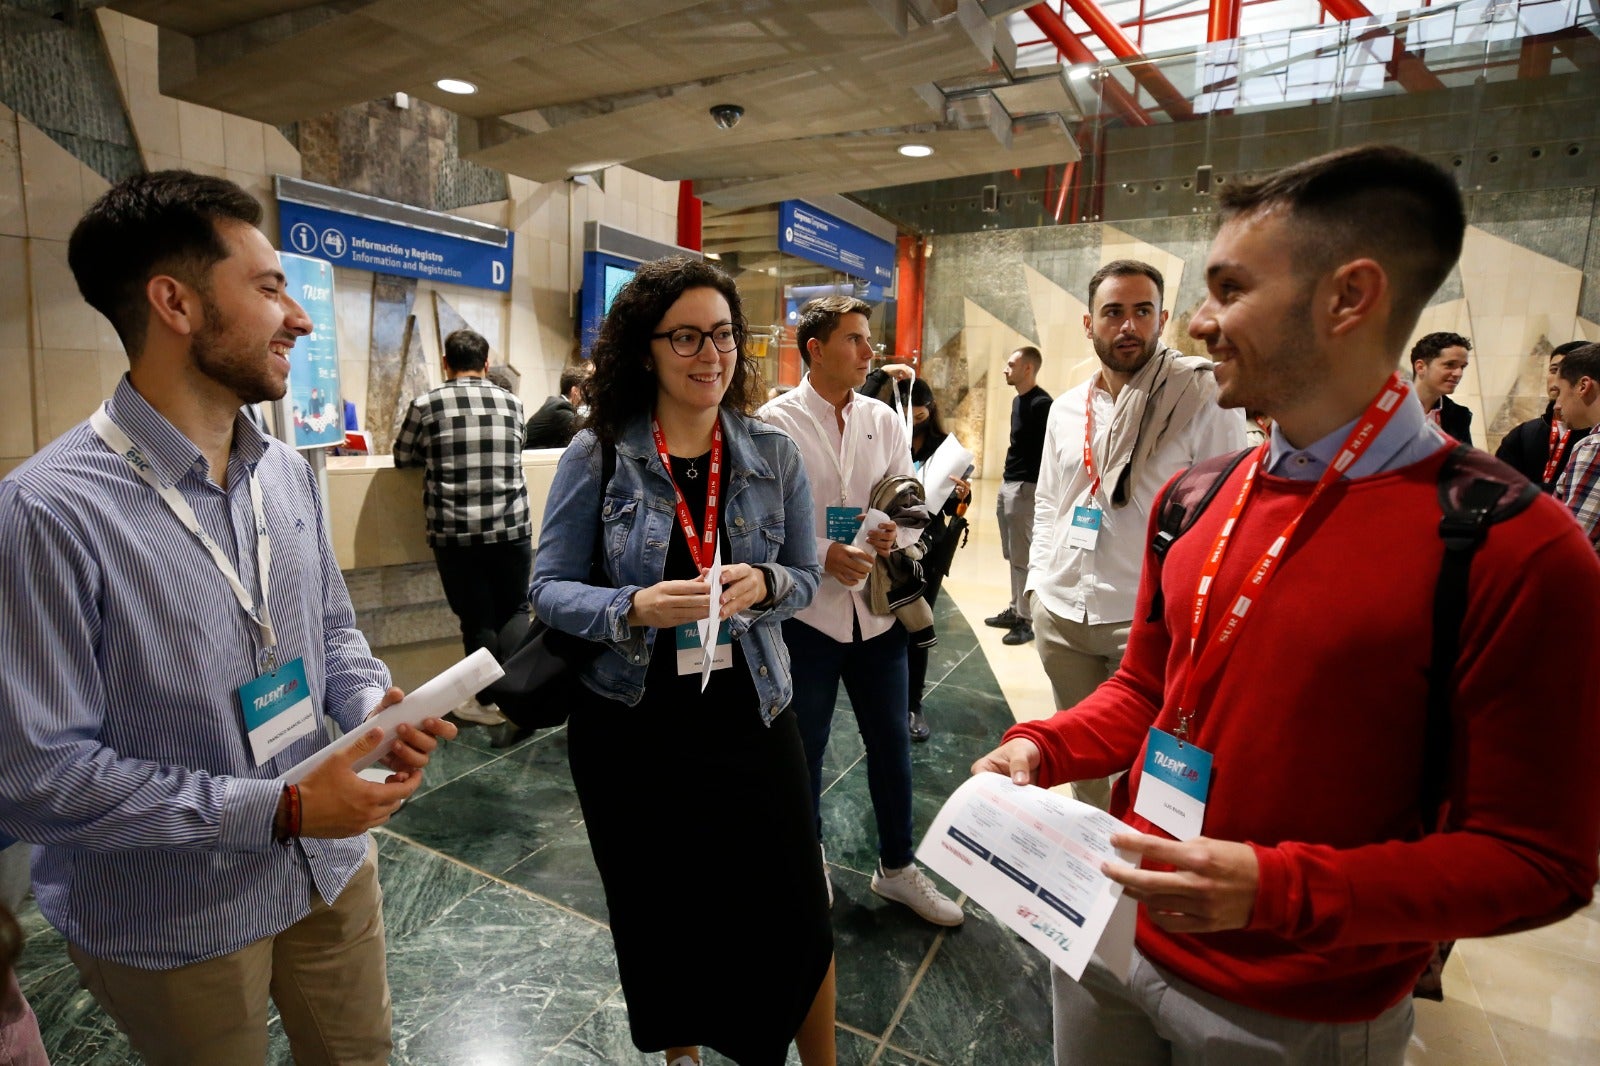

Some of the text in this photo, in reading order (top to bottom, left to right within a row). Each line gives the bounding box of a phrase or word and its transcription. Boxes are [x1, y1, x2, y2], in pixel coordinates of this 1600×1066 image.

[352, 236, 443, 262] Información y Registro
[352, 250, 462, 278] Information and Registration
[492, 260, 505, 285] D
[1211, 539, 1225, 563] SUR
[1252, 558, 1272, 584] SUR
[1193, 597, 1204, 623] SUR
[1219, 617, 1238, 643] SUR
